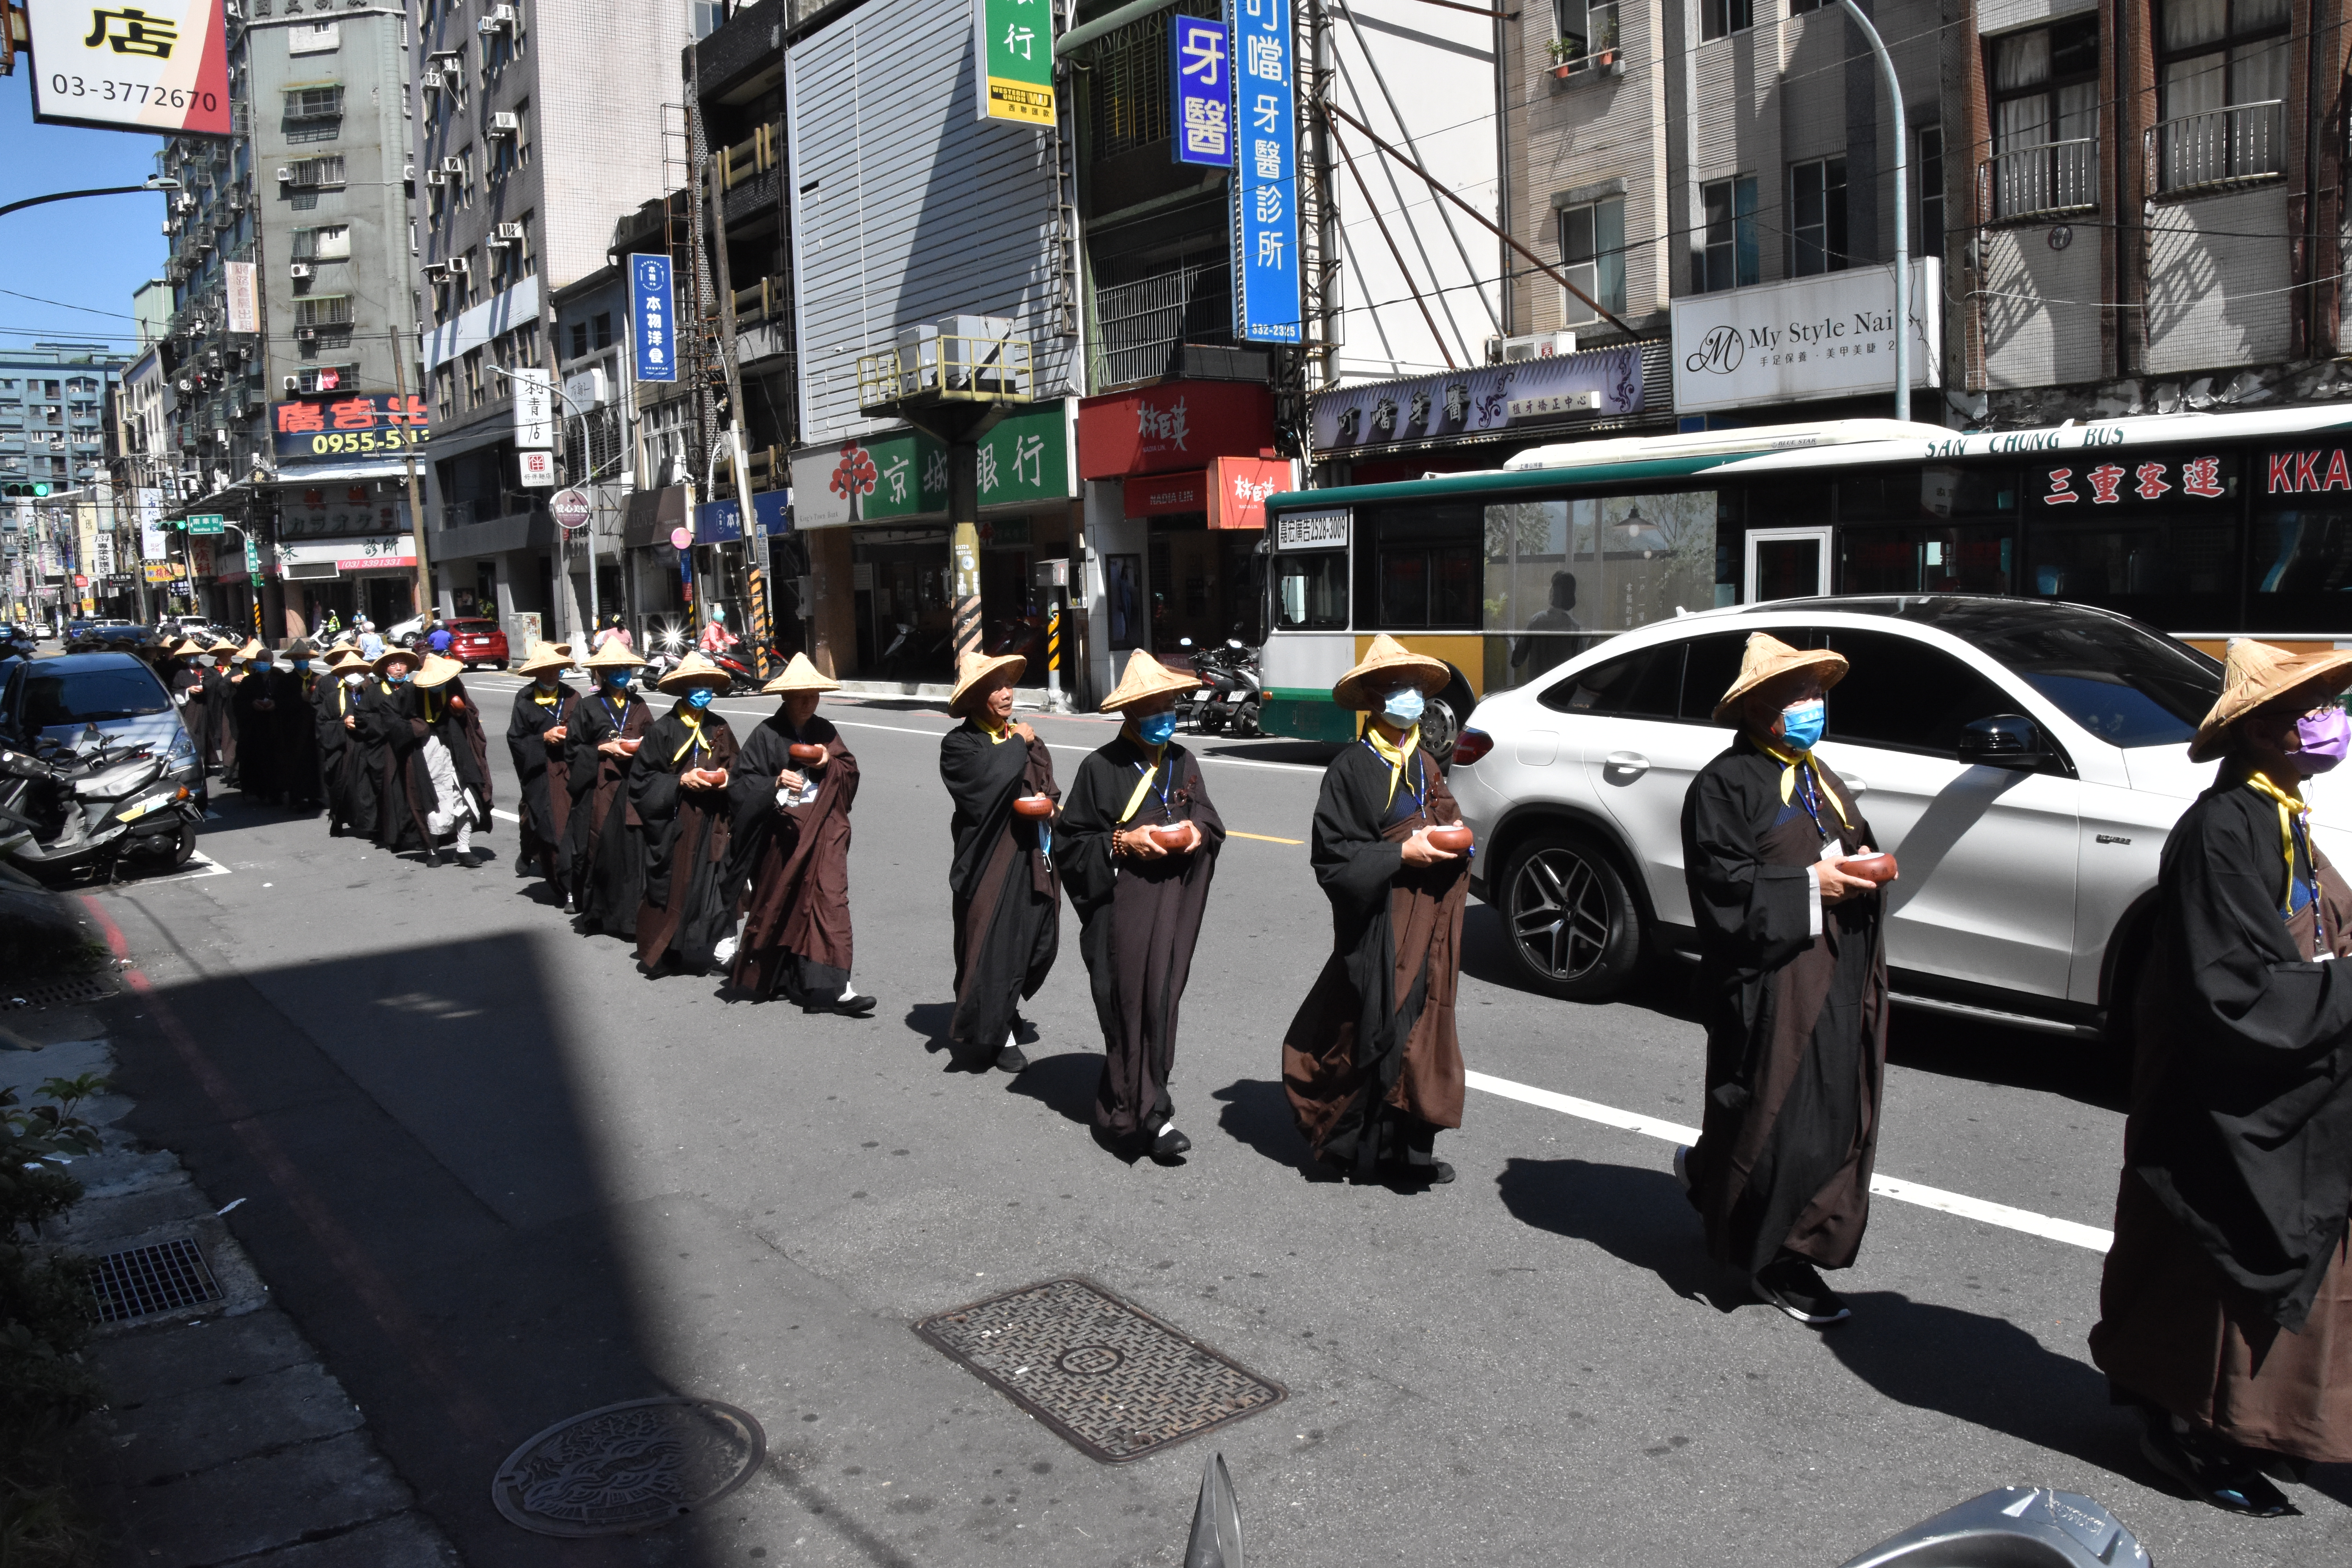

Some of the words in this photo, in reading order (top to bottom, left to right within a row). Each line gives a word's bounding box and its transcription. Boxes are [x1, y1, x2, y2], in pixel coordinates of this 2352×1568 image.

[84, 9, 178, 59] 店
[1004, 0, 1034, 60] 行
[53, 74, 217, 112] 03-3772670
[992, 86, 1026, 96] WESTERN
[1003, 94, 1026, 103] UNION
[1182, 28, 1227, 155] 牙醫
[1009, 104, 1050, 118] 西聯匯款
[646, 296, 663, 363] 本物洋食
[1252, 323, 1296, 337] 332-2325
[1748, 327, 1782, 350] My
[1789, 317, 1845, 345] Style
[1853, 309, 1913, 335] Nai
[1338, 383, 1468, 436] 叮噹牙醫
[1513, 396, 1586, 415] 植牙矯正中心
[1925, 438, 1969, 457] SAN
[1989, 431, 2060, 454] CHUNG
[2082, 426, 2125, 447] BUS
[883, 435, 1044, 505] 京城銀行
[2044, 456, 2225, 505] 三重客運
[1150, 494, 1175, 505] NADIA
[1179, 490, 1193, 503] LIN
[1280, 516, 1346, 544] 嘉宏廣告2528-3009
[361, 558, 401, 567] 3391331
[363, 538, 399, 557] 診所
